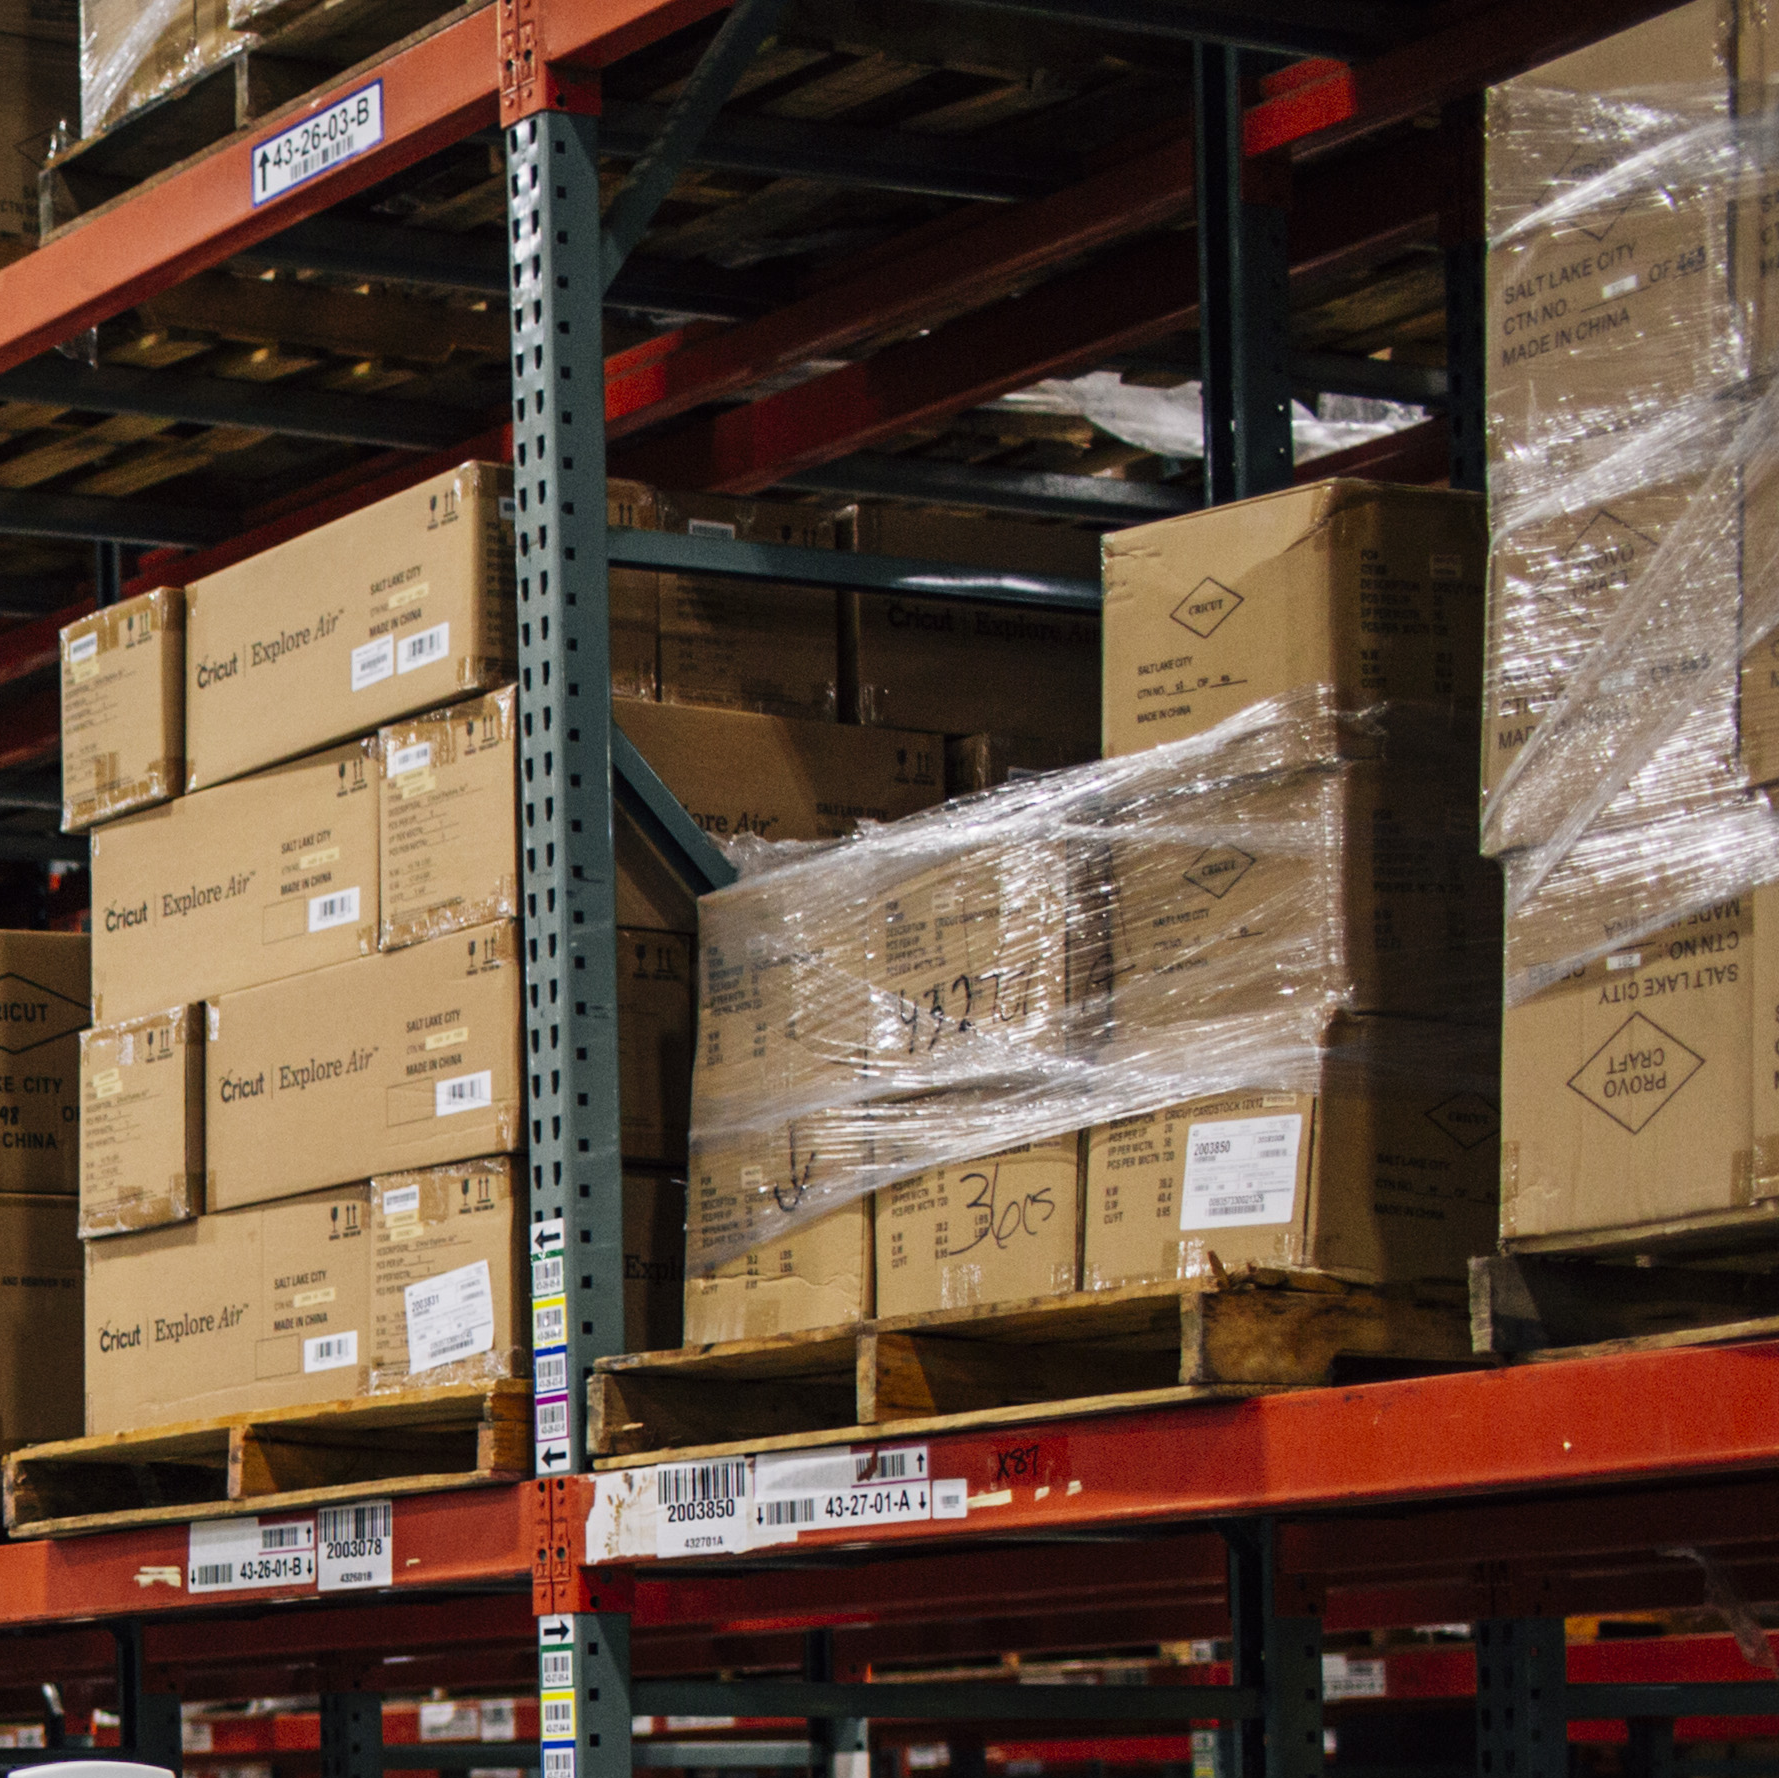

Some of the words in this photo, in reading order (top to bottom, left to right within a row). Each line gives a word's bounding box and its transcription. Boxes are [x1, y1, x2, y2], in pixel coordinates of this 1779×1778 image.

[273, 97, 369, 168] 43-26-03-B
[1505, 275, 1545, 304] SALT
[1549, 261, 1592, 289] LAKE
[1597, 244, 1636, 271] CITY
[1504, 310, 1538, 335] CTN
[1649, 260, 1671, 283] OF
[1502, 335, 1550, 367] MADE
[1555, 328, 1571, 347] IN
[1576, 307, 1630, 341] CHINA
[370, 580, 387, 595] SALT
[387, 571, 404, 589] LAKE
[405, 565, 422, 583] CITY
[1189, 599, 1224, 616] CRICUT
[369, 619, 390, 637] MADE
[391, 617, 399, 630] IN
[400, 608, 422, 628] CHINA
[888, 606, 954, 634] Cricut
[975, 611, 1061, 643] Explore
[197, 653, 238, 689] Cricut
[251, 625, 310, 667] Explore
[1138, 664, 1155, 676] SALT
[1155, 659, 1173, 672] LAKE
[1175, 656, 1193, 668] CITY
[1137, 688, 1153, 700] CTN
[1197, 678, 1209, 688] OF
[1137, 711, 1158, 723] MADE
[1159, 709, 1167, 719] IN
[1167, 705, 1191, 718] CHINA
[282, 841, 297, 855] SALT
[298, 835, 315, 850] LAKE
[317, 830, 331, 845] CITY
[281, 881, 301, 896] MADE
[302, 879, 310, 889] IN
[311, 871, 332, 887] CHINA
[105, 900, 147, 932] Cricut
[162, 884, 222, 918] Explore
[1702, 931, 1740, 956] CTN
[1644, 970, 1689, 998] LAKE
[1696, 963, 1739, 989] SALT
[1598, 981, 1639, 1005] CITY
[406, 1017, 424, 1033] SALT
[424, 1013, 443, 1029] LAKE
[444, 1009, 461, 1025] CITY
[406, 1061, 426, 1076] MADE
[428, 1059, 437, 1072] IN
[438, 1053, 462, 1069] CHINA
[1606, 1048, 1666, 1075] CRAFT
[23, 1077, 63, 1094] CITY
[220, 1070, 265, 1103] Cricut
[279, 1058, 342, 1090] Explore
[1603, 1071, 1667, 1098] PROVO
[1164, 1109, 1191, 1121] CRICUT
[1193, 1102, 1240, 1117] CARDSTOCK
[3, 1132, 58, 1149] CHINA
[1194, 1140, 1231, 1156] 2003850
[1107, 1159, 1121, 1170] PCS
[1121, 1157, 1135, 1168] PER
[274, 1275, 291, 1290] SALT
[292, 1272, 309, 1287] LAKE
[310, 1270, 327, 1284] CITY
[99, 1320, 141, 1352] Cricut
[154, 1313, 214, 1343] Explore
[274, 1317, 294, 1331] MADE
[295, 1315, 304, 1328] IN
[305, 1312, 328, 1326] CHINA
[996, 1445, 1040, 1478] X87
[667, 1499, 735, 1523] 2003850
[825, 1490, 911, 1519] 43-27-01-A
[327, 1538, 383, 1559] 2003078
[684, 1536, 724, 1550] 432701A
[240, 1557, 301, 1580] 43-26-01-B
